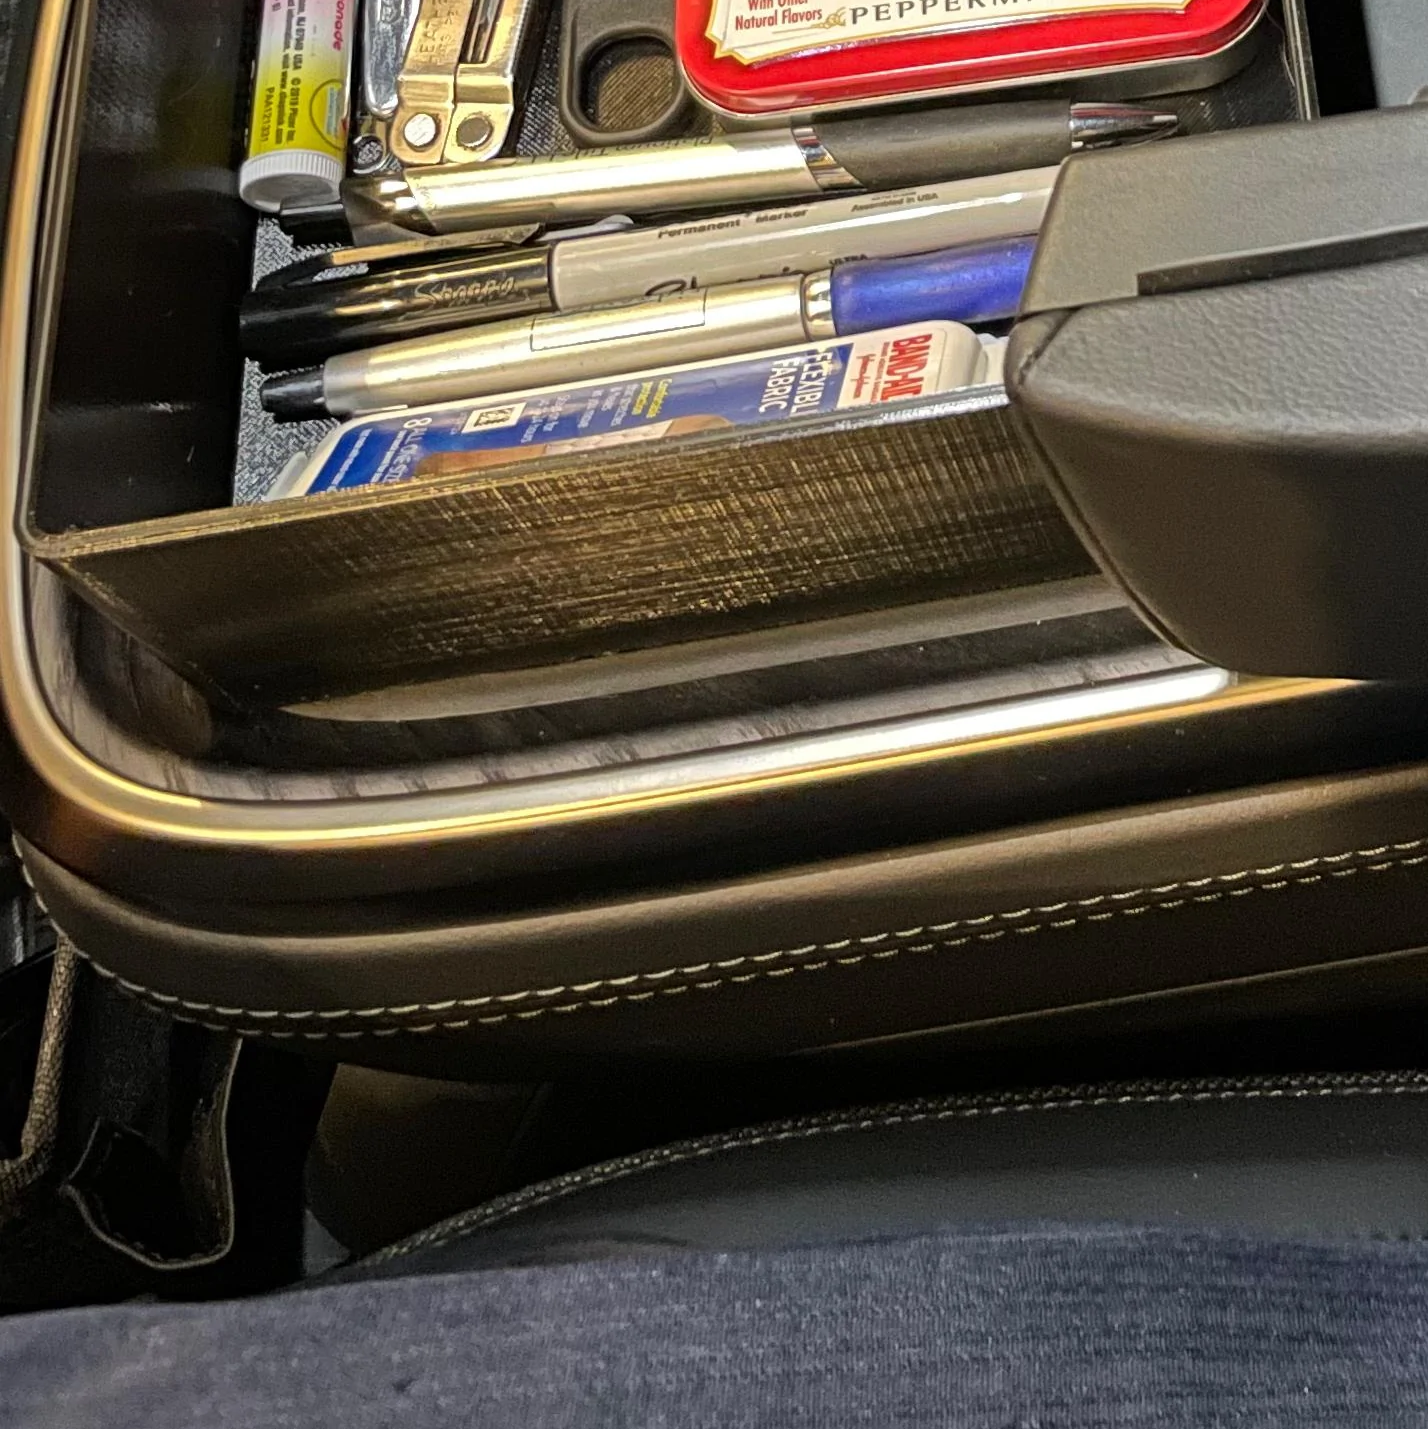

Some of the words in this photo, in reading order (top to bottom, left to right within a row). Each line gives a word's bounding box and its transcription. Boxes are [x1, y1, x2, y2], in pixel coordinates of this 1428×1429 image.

[735, 9, 778, 31] Natural
[781, 7, 823, 25] Flavors
[292, 54, 303, 70] USA
[658, 218, 740, 240] Permanent
[755, 208, 808, 224] Marker
[758, 357, 799, 414] FABRIC
[403, 416, 433, 430] 8
